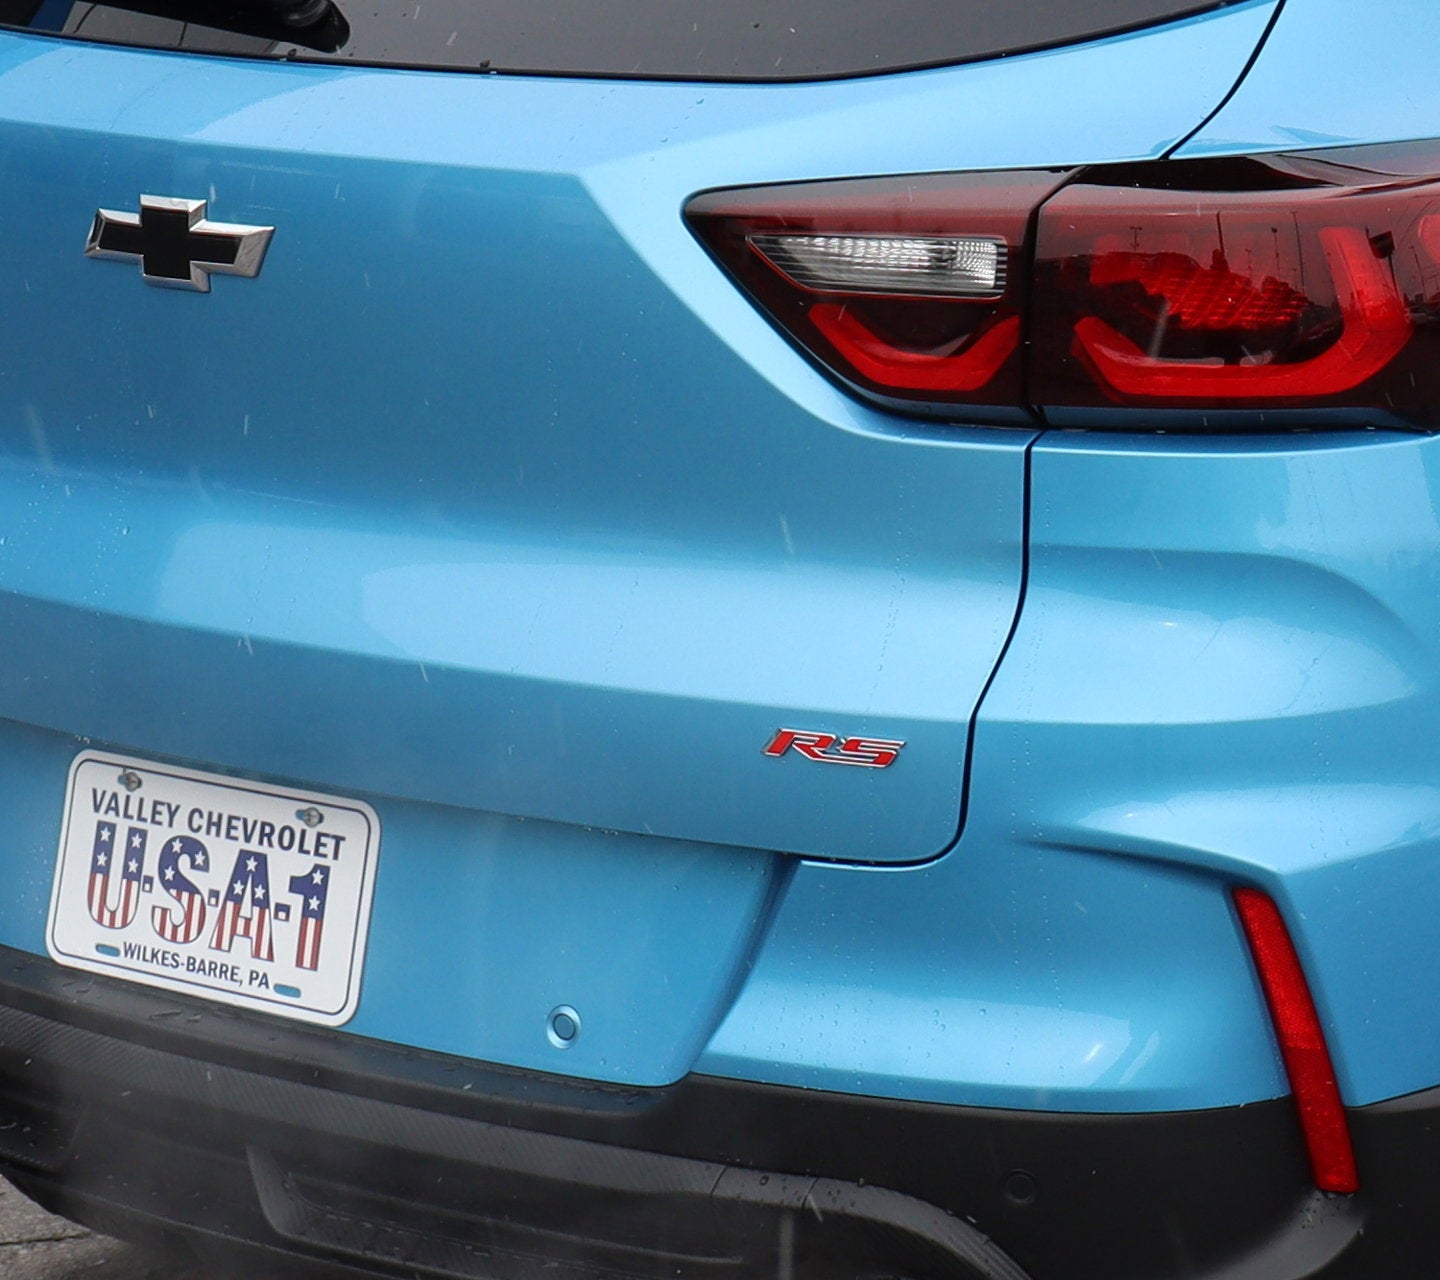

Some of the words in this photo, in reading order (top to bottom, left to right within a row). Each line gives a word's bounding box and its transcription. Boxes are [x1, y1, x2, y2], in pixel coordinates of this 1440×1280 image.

[762, 727, 908, 769] RS
[92, 788, 181, 827] VALLEY
[187, 807, 347, 861] CHEVROLET
[122, 941, 244, 987] WILKES-BARRE,
[249, 970, 270, 990] PA
